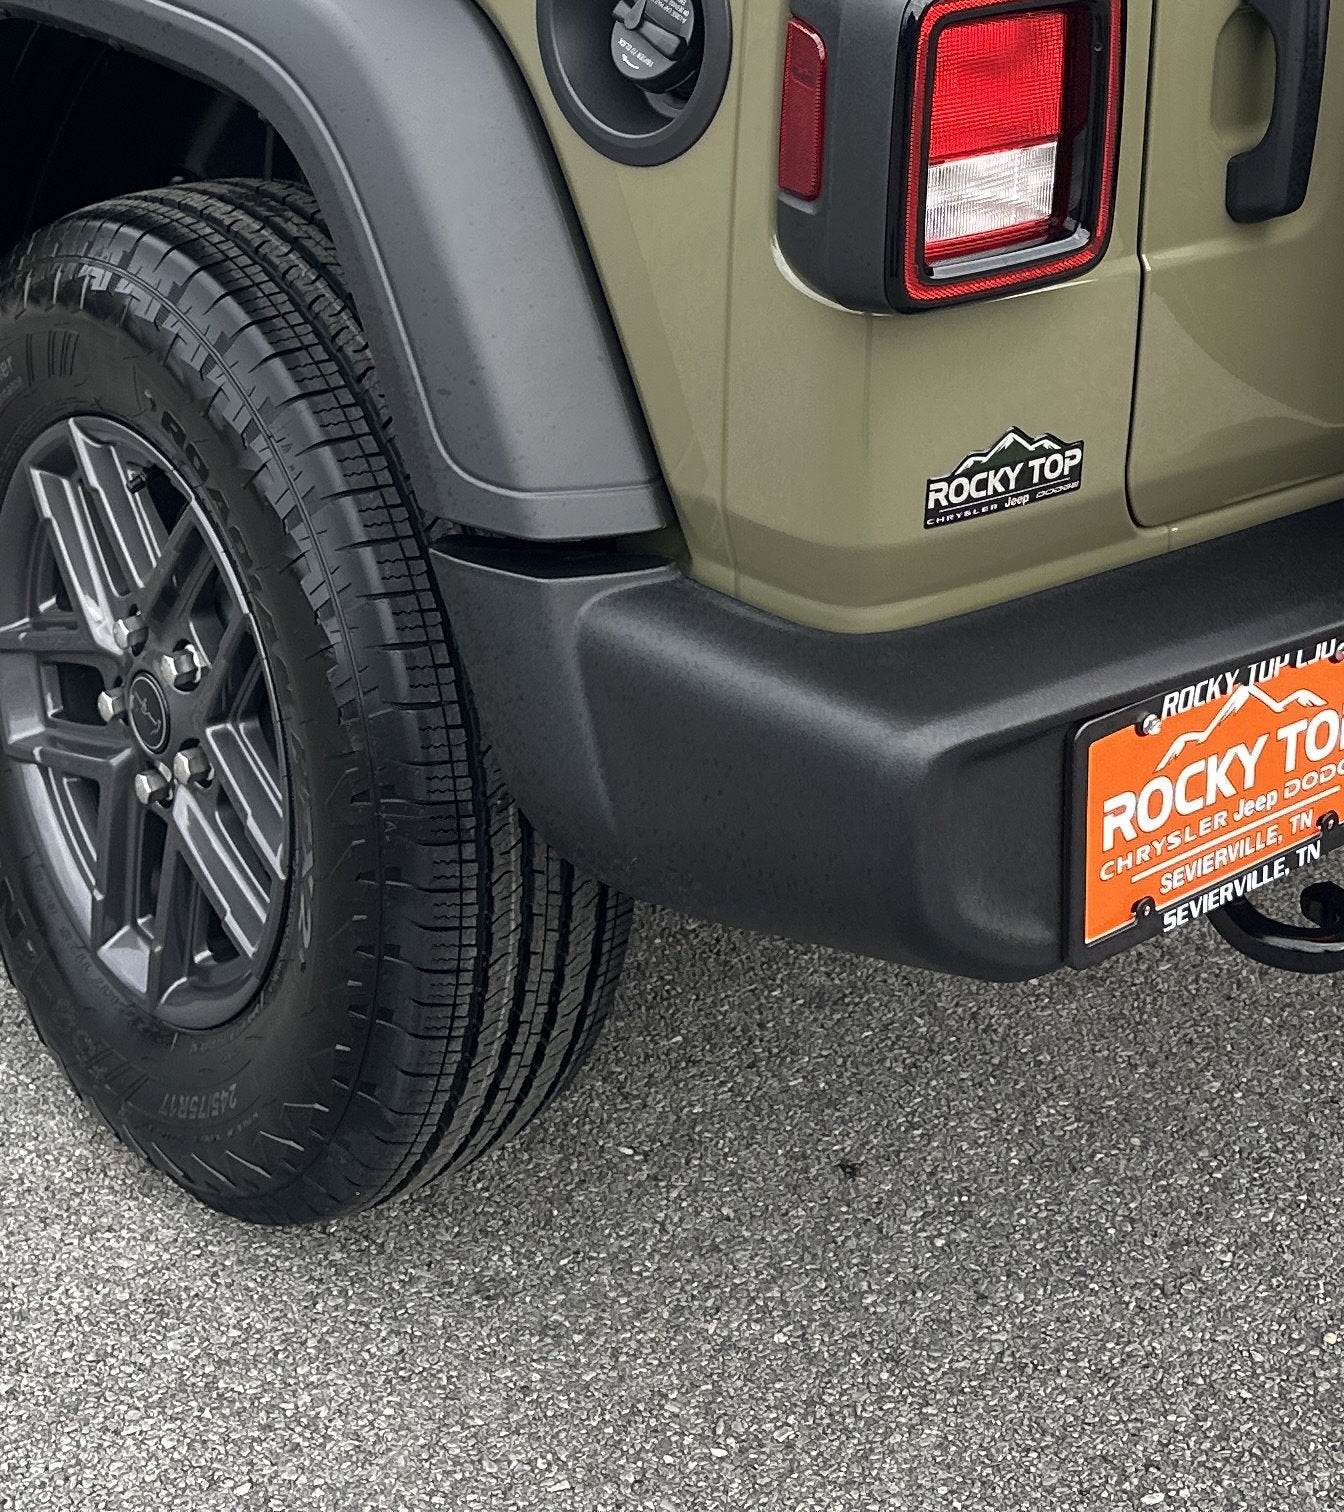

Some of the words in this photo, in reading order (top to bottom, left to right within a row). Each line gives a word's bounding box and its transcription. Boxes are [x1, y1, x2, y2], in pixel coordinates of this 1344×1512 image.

[926, 503, 998, 525] CHRYSLER
[1004, 493, 1030, 508] Jeep
[927, 462, 1025, 510] ROCKY
[1028, 448, 1082, 484] TOP
[1161, 669, 1240, 719] ROCKY
[1098, 809, 1229, 882] CHRYSLER
[1232, 789, 1278, 822] Jeep
[1101, 734, 1270, 852] ROCKY
[1159, 824, 1283, 896] SEVIERVILLE,
[1288, 810, 1314, 834] TN
[1163, 858, 1291, 934] SEVIERVILLE,
[1295, 840, 1322, 868] TN
